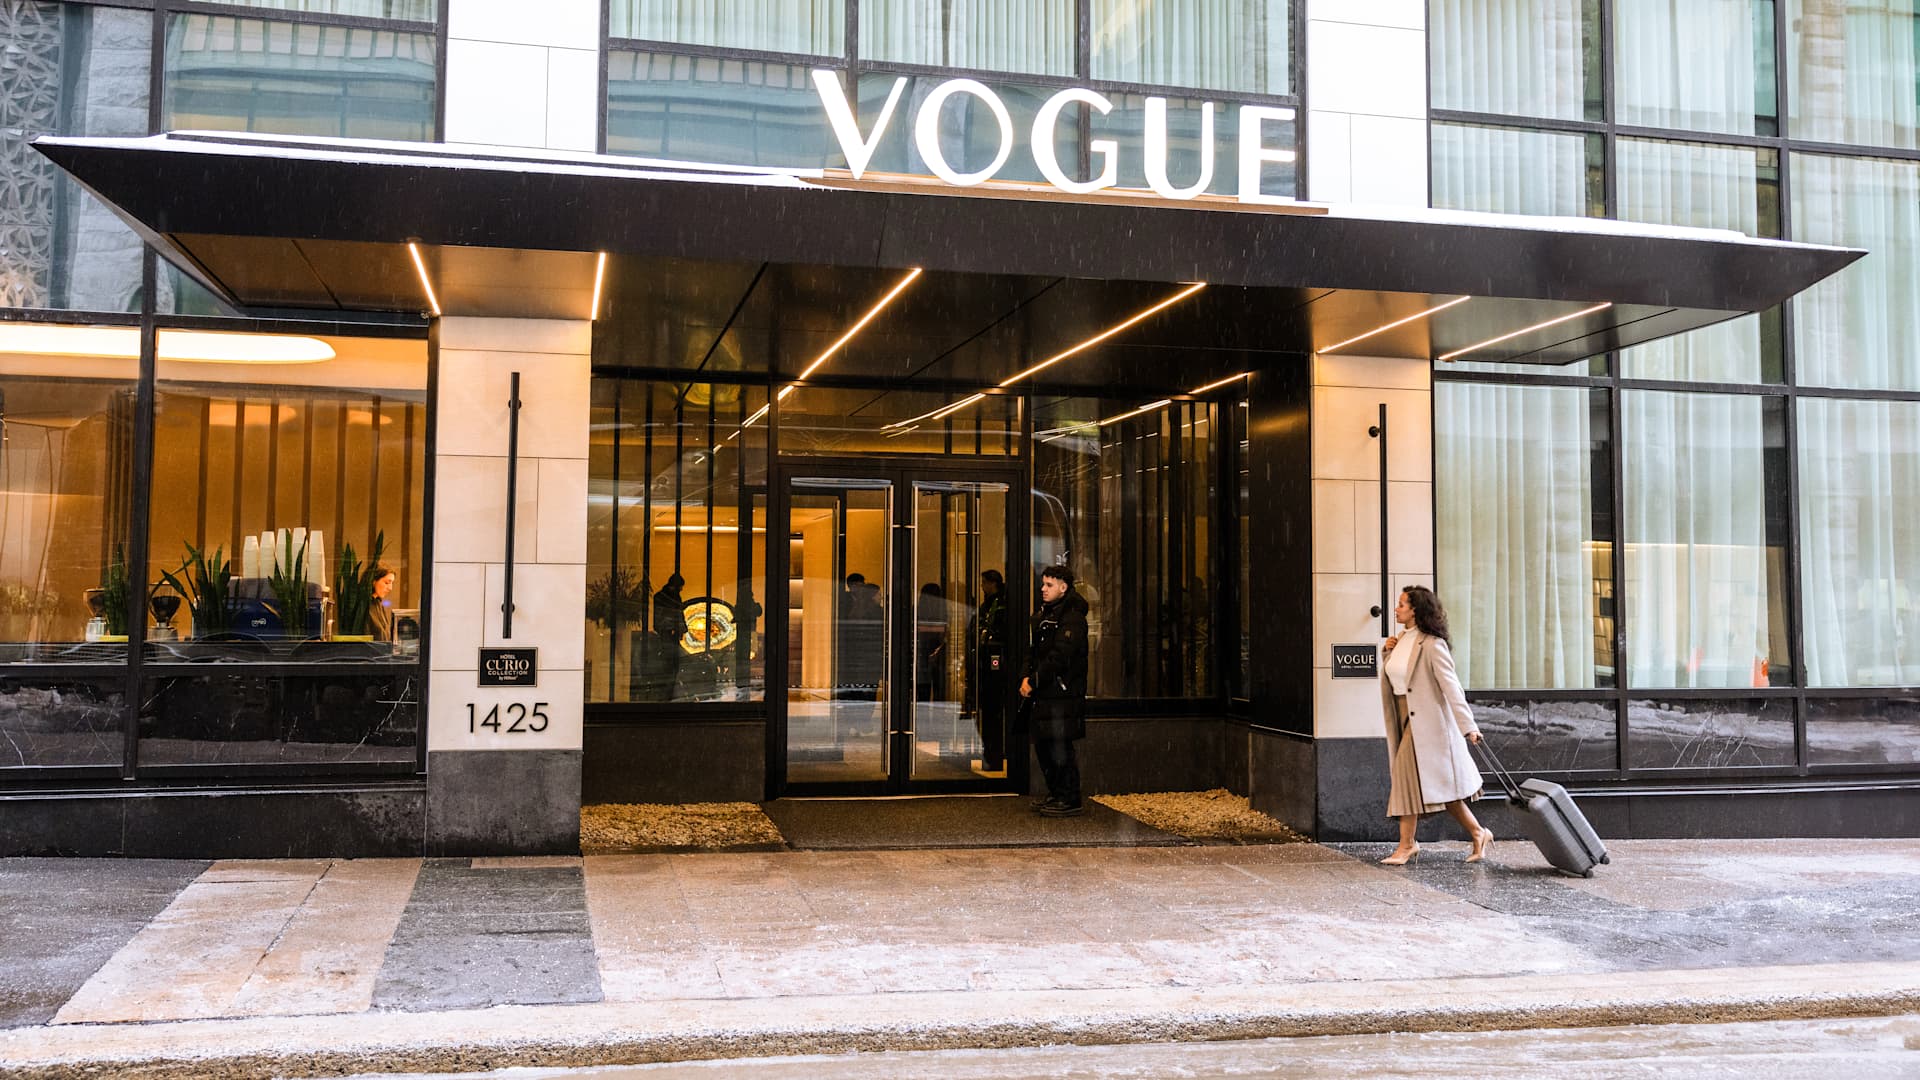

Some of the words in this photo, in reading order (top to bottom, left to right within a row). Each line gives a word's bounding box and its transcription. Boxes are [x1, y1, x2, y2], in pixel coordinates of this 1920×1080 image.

[812, 69, 1296, 203] VOGUE
[486, 659, 530, 671] CURIO
[1336, 654, 1375, 665] VOGUE
[466, 702, 549, 734] 1425
